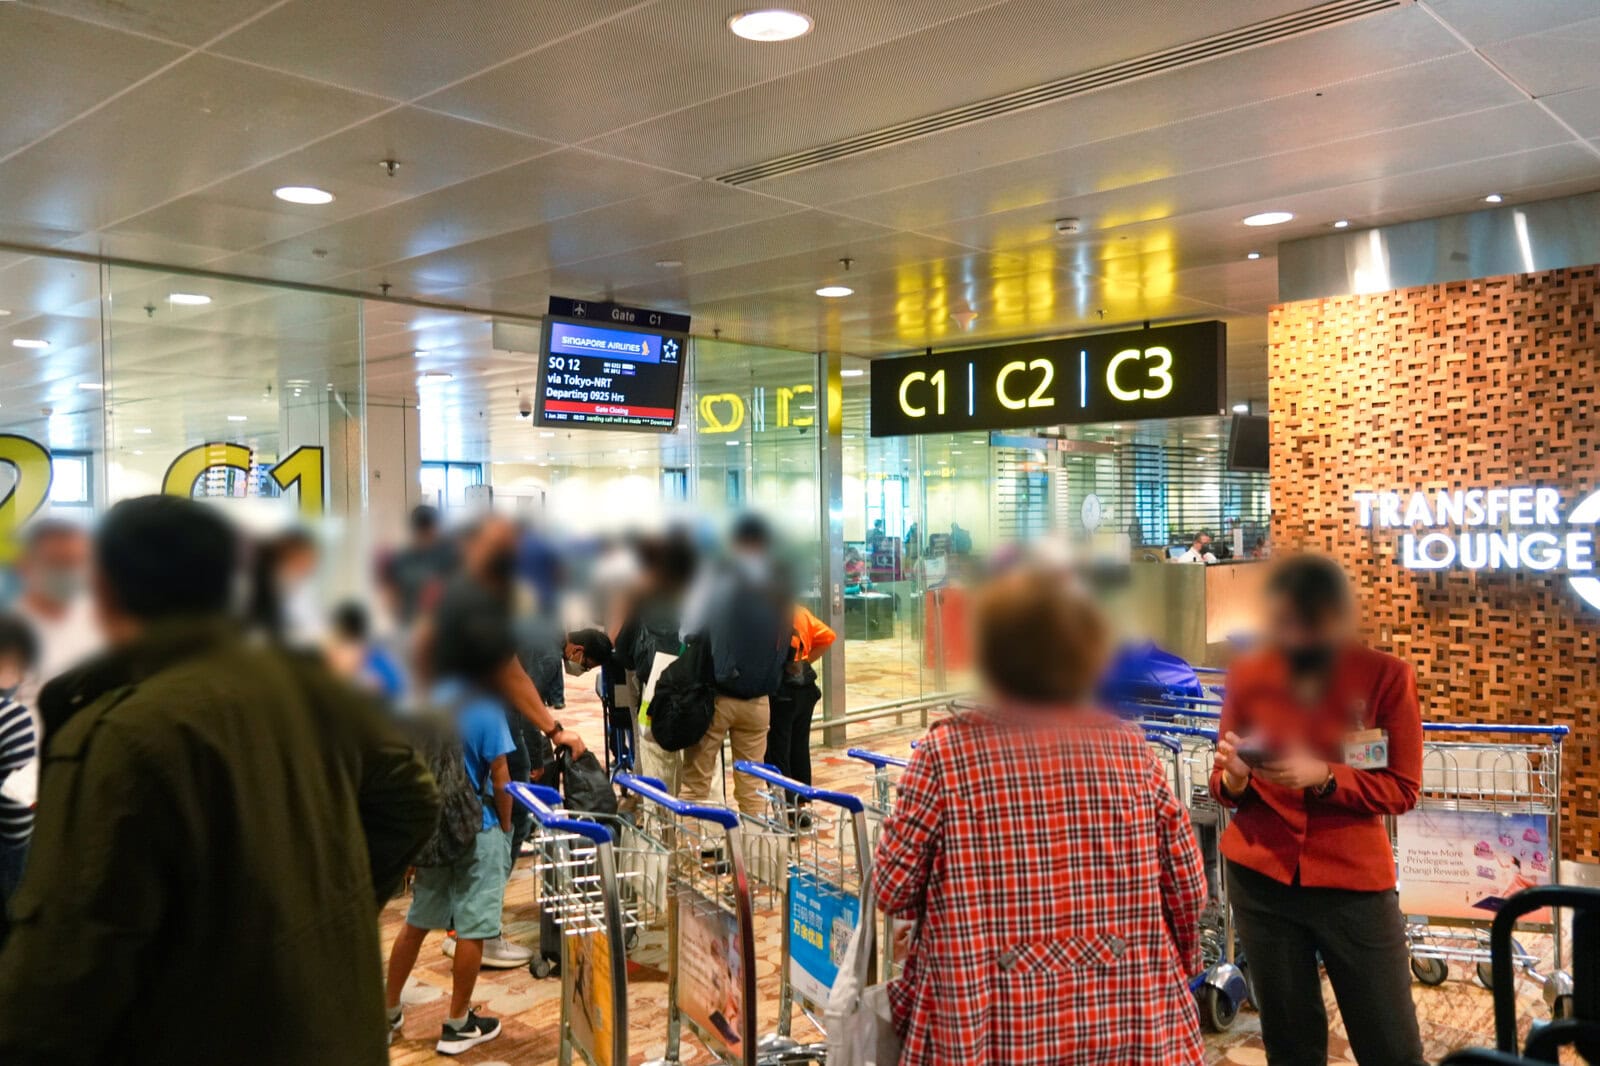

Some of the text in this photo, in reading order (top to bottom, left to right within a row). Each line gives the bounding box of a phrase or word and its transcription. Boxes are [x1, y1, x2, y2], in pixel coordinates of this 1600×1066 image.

[611, 308, 662, 326] Gate C1
[561, 336, 641, 353] SINGAPORE AIRLINES
[548, 357, 581, 371] SQ 12
[547, 374, 613, 389] via Tokyo-NRT
[899, 346, 1173, 418] C1 C2 C3
[546, 387, 625, 402] Departing 0925 Hrs
[595, 405, 629, 416] Gate Closing
[1351, 487, 1561, 528] TRANSFER
[1402, 531, 1593, 571] LOUNGE
[1406, 855, 1449, 866] Privileges
[1440, 849, 1464, 858] More
[1402, 865, 1470, 877] Changi Rewards
